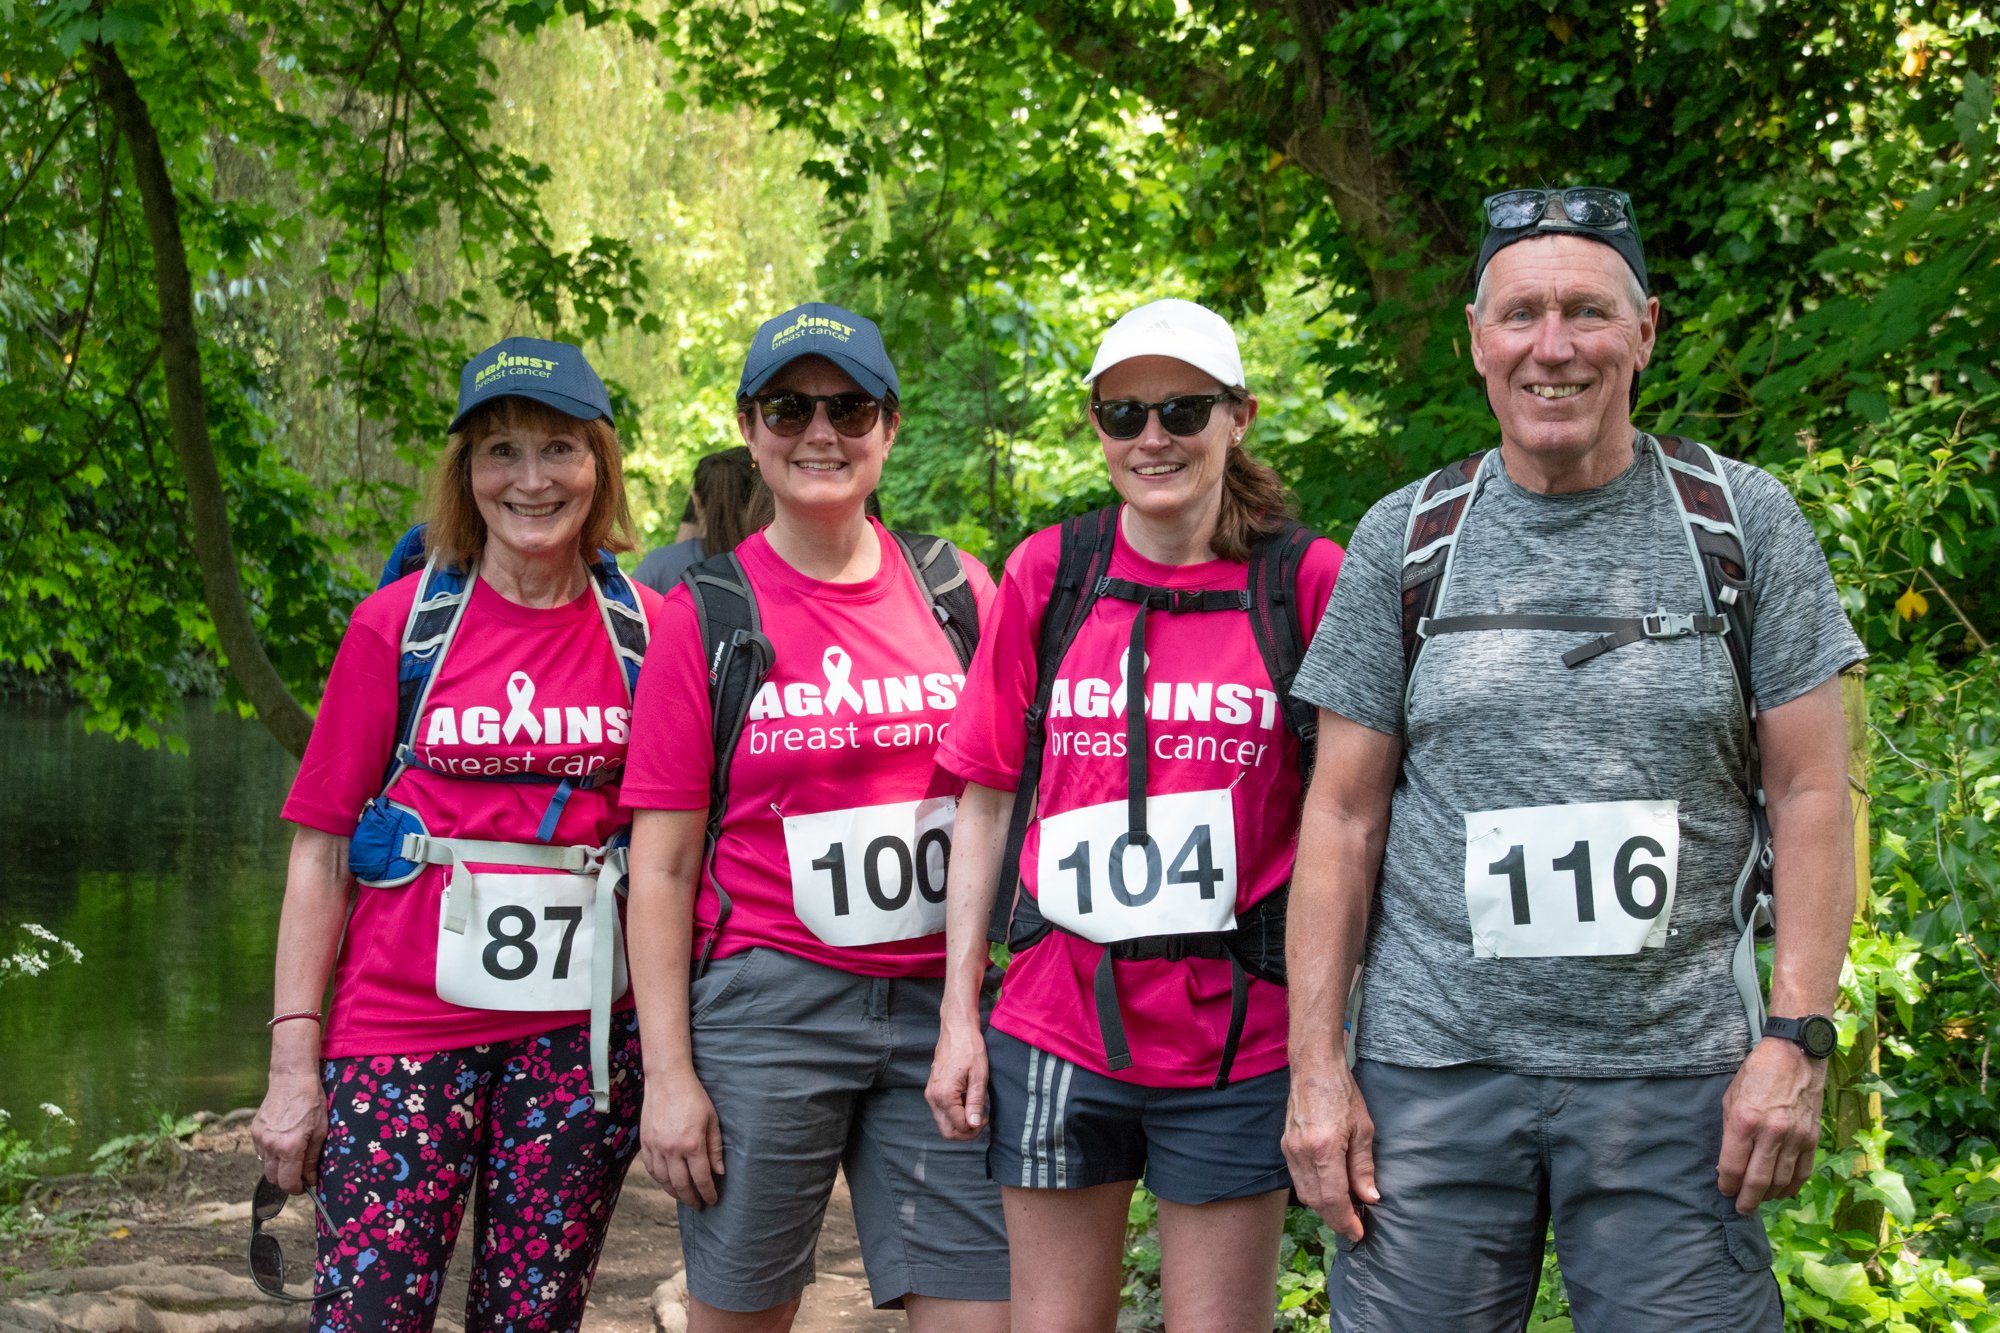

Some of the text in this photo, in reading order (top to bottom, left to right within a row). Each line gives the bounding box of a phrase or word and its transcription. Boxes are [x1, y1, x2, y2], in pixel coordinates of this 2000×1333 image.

[772, 327, 850, 351] breast cancer
[475, 367, 551, 392] breast cancer
[1403, 562, 1439, 582] OSPREY
[426, 670, 633, 745] AGAINS
[750, 722, 950, 755] breast canc
[1051, 723, 1268, 767] breas cancer
[426, 746, 535, 776] breast
[812, 828, 952, 917] 100
[1058, 824, 1224, 915] 104
[1489, 835, 1668, 925] 116
[482, 905, 583, 981] 87
